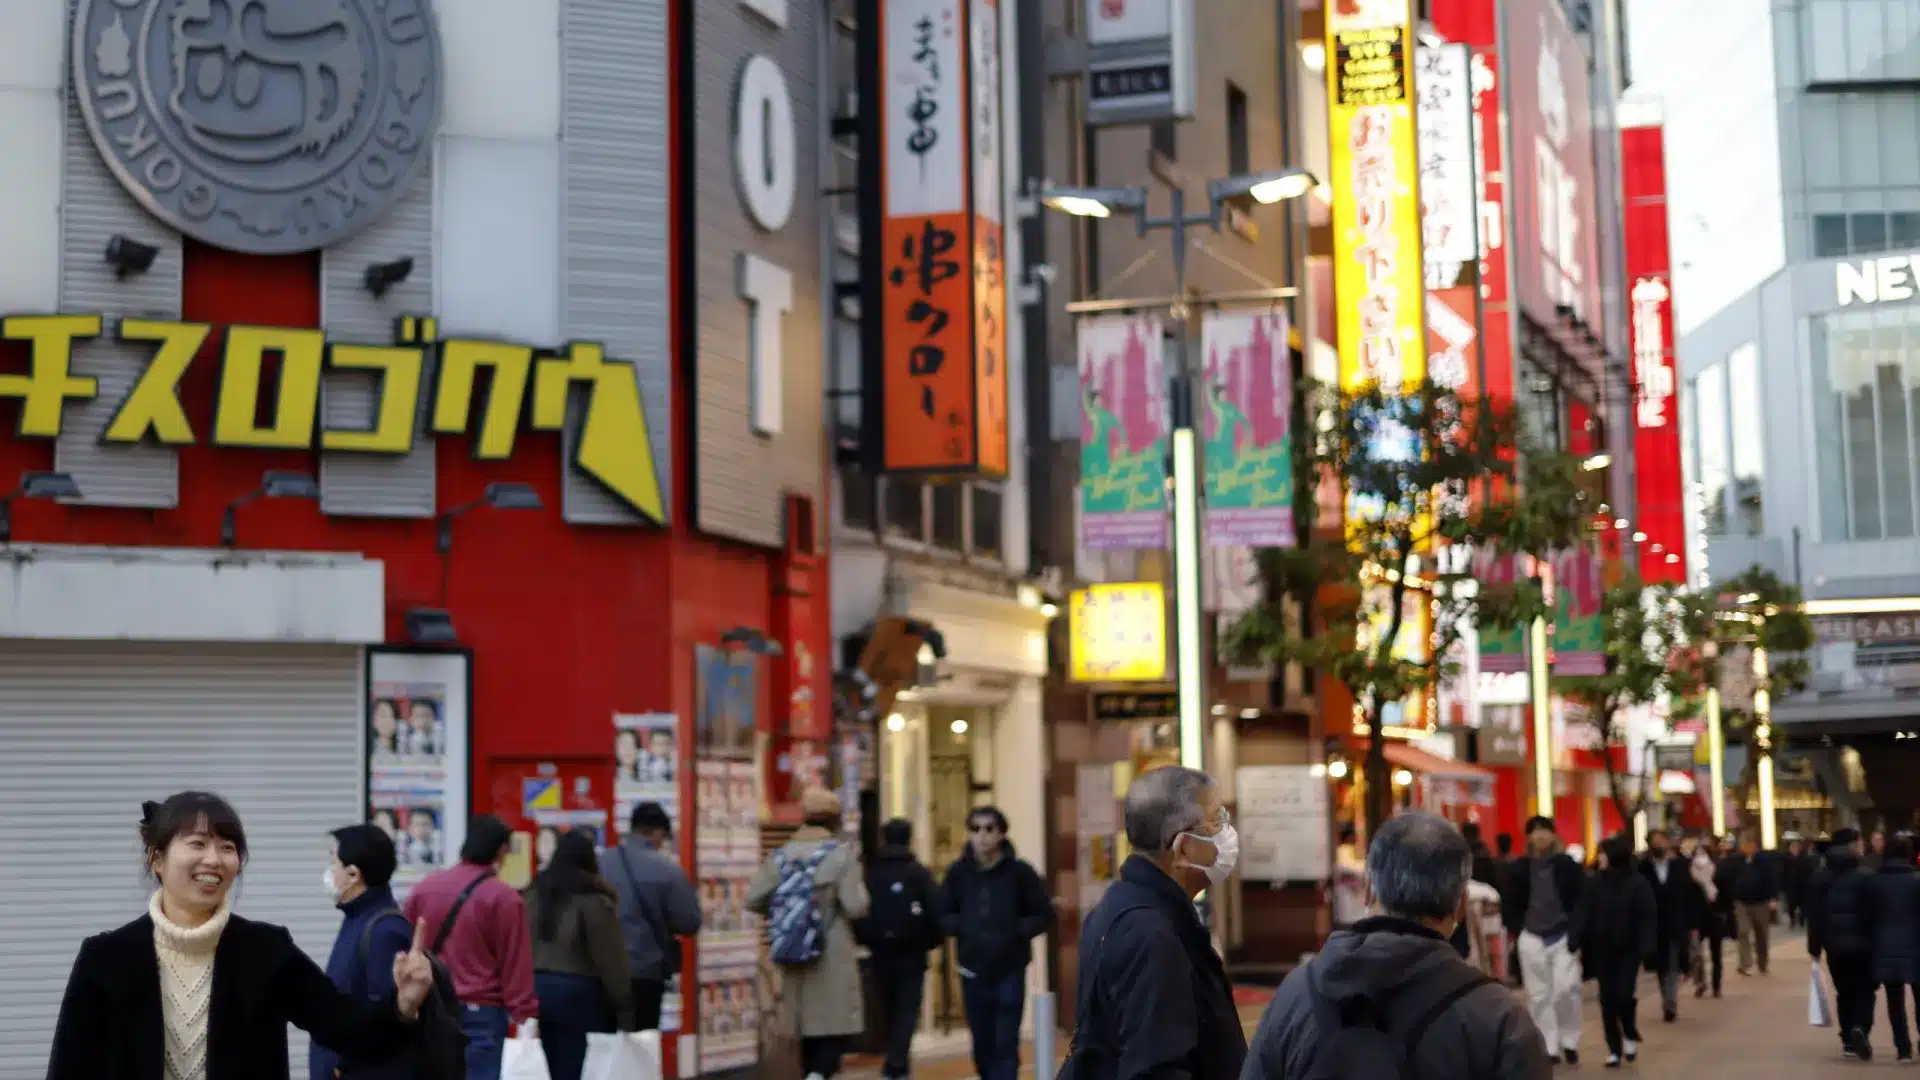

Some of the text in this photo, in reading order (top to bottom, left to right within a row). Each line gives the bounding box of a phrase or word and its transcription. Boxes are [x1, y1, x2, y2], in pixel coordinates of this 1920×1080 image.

[97, 80, 218, 222] GOKU
[741, 0, 797, 435] OT
[889, 219, 960, 420] 串クロー
[1836, 254, 1920, 306] NE
